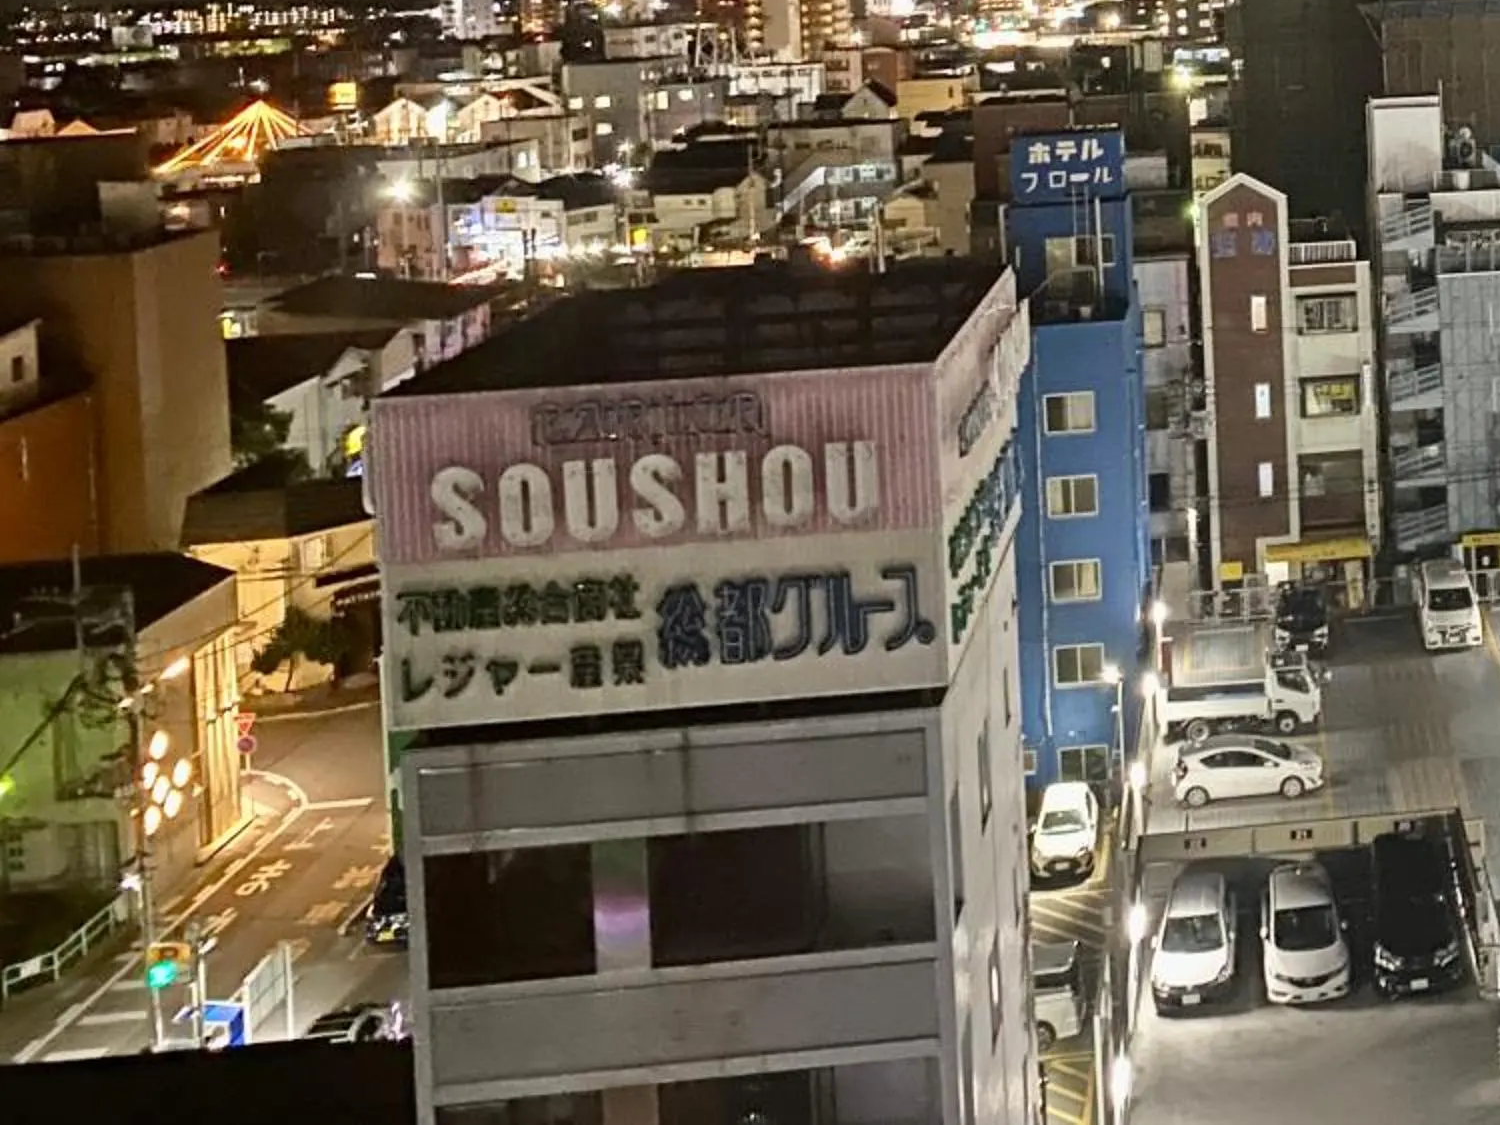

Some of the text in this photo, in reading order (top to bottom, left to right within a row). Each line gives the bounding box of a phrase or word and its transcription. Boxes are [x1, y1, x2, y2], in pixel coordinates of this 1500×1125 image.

[1028, 139, 1105, 165] ホテル
[1020, 166, 1113, 193] フロール
[430, 440, 881, 551] SOUSHOU
